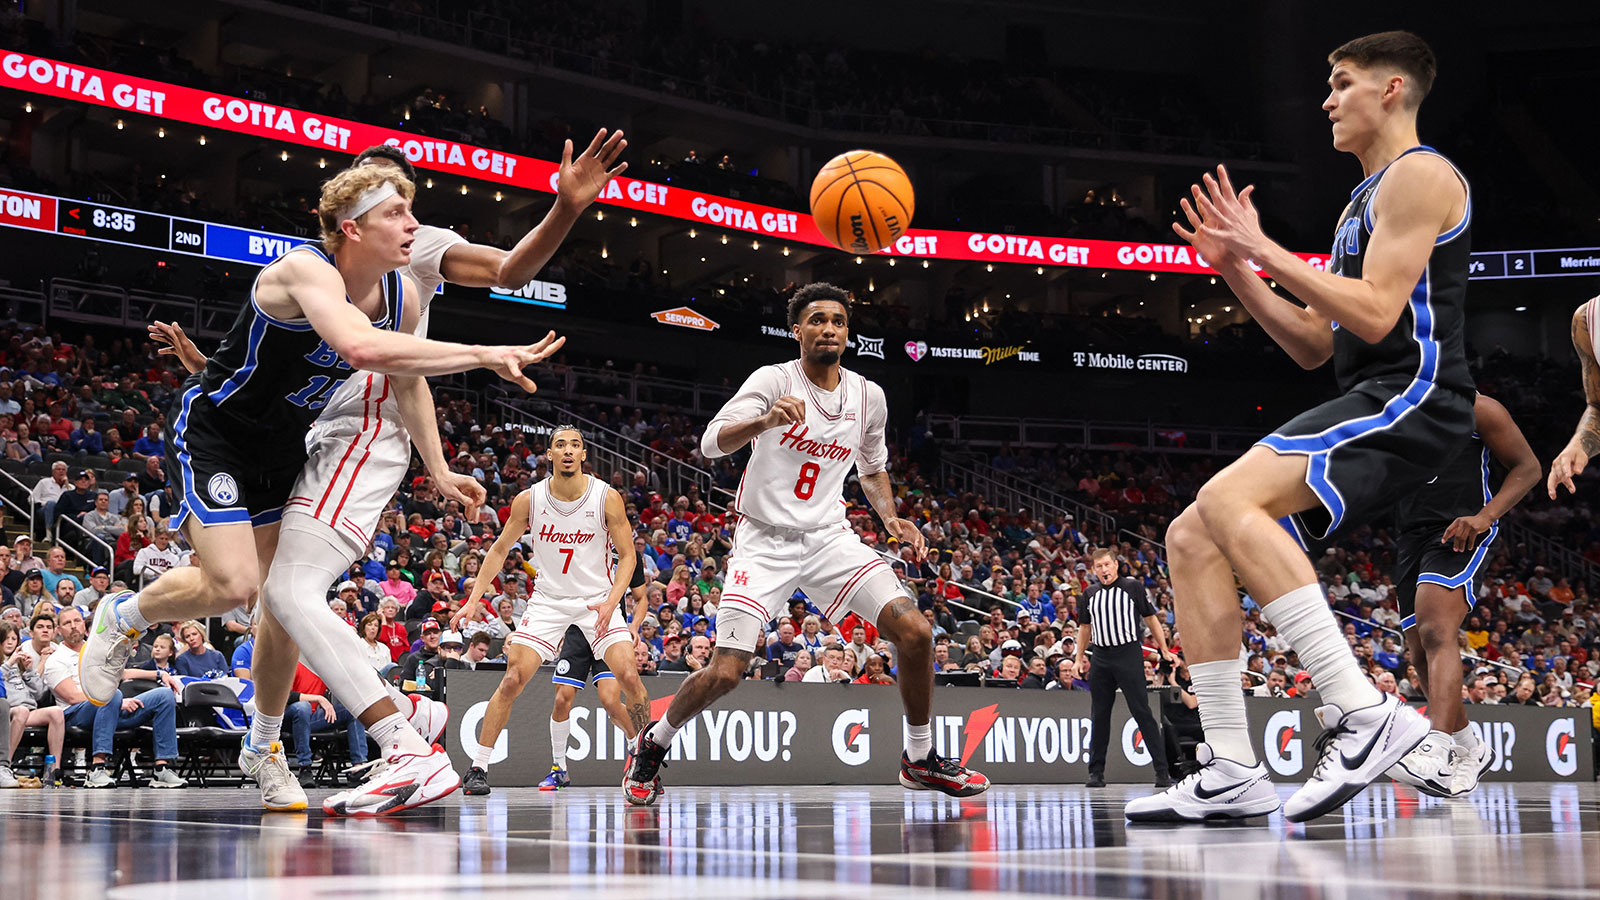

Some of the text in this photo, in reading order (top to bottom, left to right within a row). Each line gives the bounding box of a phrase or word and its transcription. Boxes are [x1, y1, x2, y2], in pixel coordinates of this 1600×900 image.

[2, 53, 105, 101] GOTTA
[112, 83, 165, 115] GET
[203, 97, 297, 134] GOTTA
[302, 117, 350, 149] GET
[472, 149, 516, 177] GET
[627, 181, 668, 206] GET
[691, 197, 758, 230] GOTTA
[761, 212, 797, 233] GET
[896, 235, 938, 255] GET
[968, 234, 1045, 260] GOTTA
[1049, 245, 1089, 265] GET
[1117, 246, 1192, 265] GOTTA
[93, 208, 136, 232] 8:35
[175, 231, 201, 246] 2ND
[248, 235, 292, 258] BYU
[1514, 259, 1524, 270] 2
[665, 312, 705, 328] SERVPRO
[930, 347, 963, 358] TASTES
[963, 348, 983, 359] LIKE
[980, 345, 1025, 366] Miller
[1017, 351, 1041, 362] TIME
[1088, 353, 1134, 369] Mobile
[1136, 358, 1183, 371] CENTER
[779, 421, 852, 462] Houston
[794, 461, 821, 501] 8
[539, 524, 596, 544] Houston
[559, 548, 574, 574] 7
[459, 700, 509, 764] G
[564, 706, 592, 761] S
[701, 709, 798, 762] YOU?
[832, 708, 871, 766] G
[935, 715, 963, 762] IT
[985, 716, 1016, 763] IN
[1017, 717, 1093, 764] YOU?
[1121, 716, 1153, 767] G
[1264, 710, 1303, 777] G
[1546, 717, 1578, 777] G
